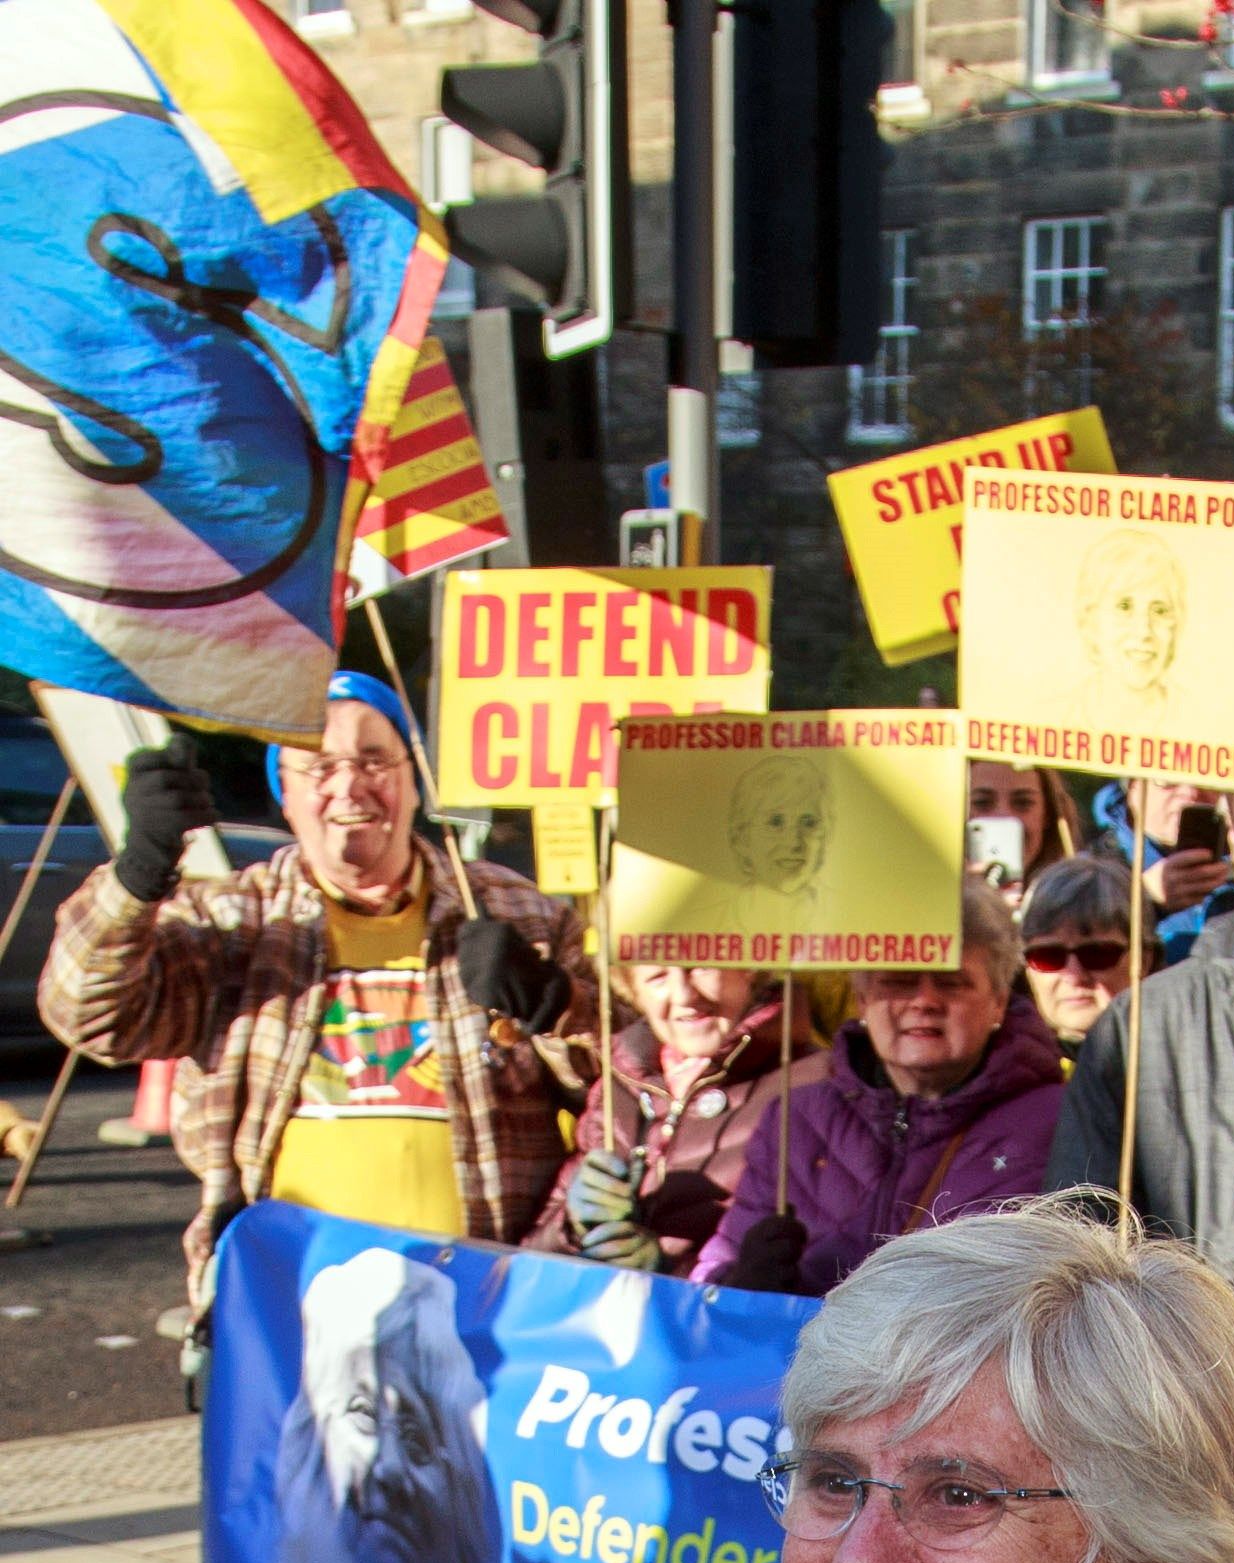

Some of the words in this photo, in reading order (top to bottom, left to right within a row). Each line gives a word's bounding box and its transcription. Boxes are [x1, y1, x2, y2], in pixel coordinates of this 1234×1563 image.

[974, 480, 1111, 518] PROFESSOR
[1120, 489, 1198, 524] CLARA
[458, 587, 759, 679] DEFEND
[471, 701, 723, 790] CLA
[626, 721, 765, 750] PROFESSOR
[769, 720, 846, 749] CLARA
[968, 719, 1092, 763] DEFENDER
[1101, 732, 1132, 766] OF
[618, 931, 744, 963] DEFENDER
[750, 932, 782, 964] OF
[789, 932, 954, 964] DEMOCRACY
